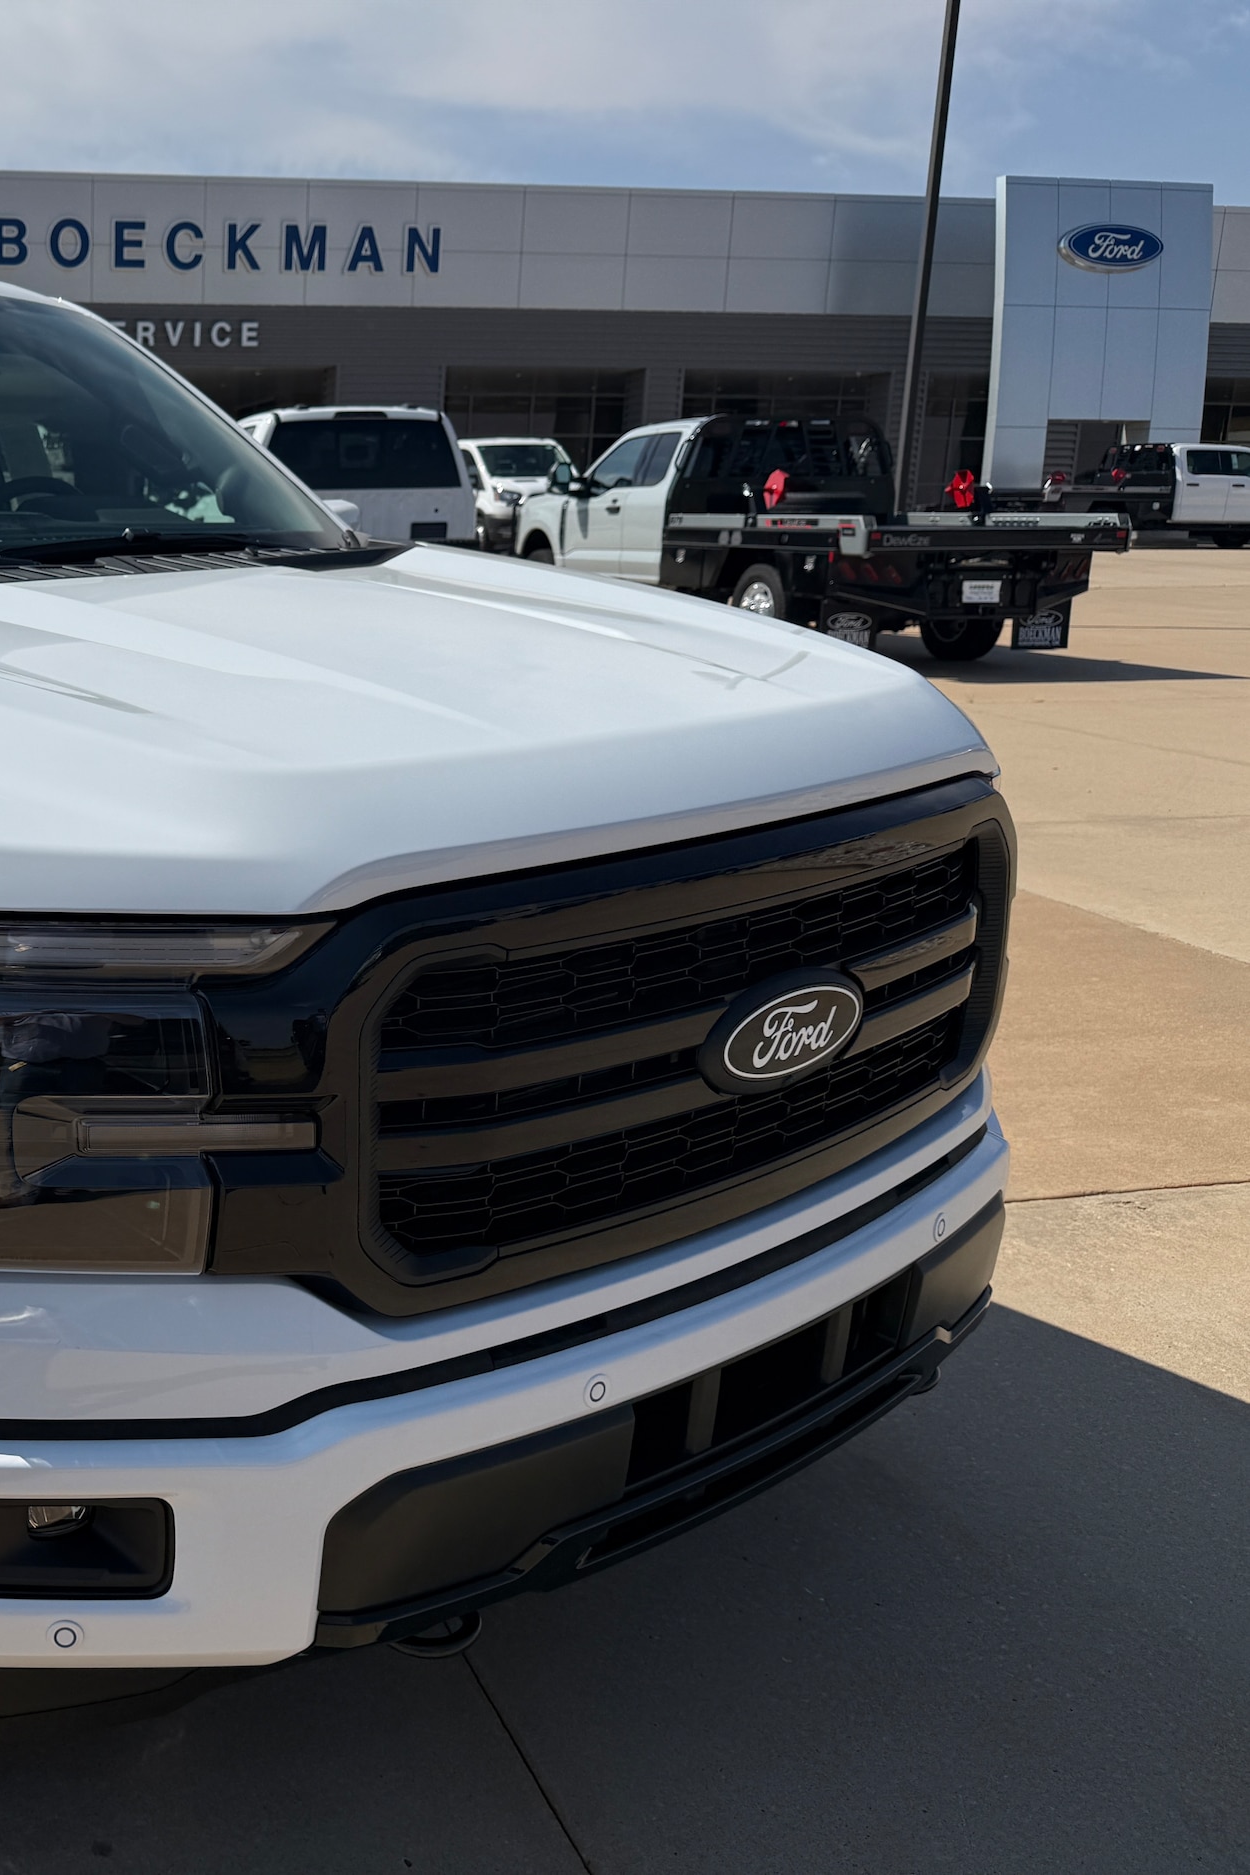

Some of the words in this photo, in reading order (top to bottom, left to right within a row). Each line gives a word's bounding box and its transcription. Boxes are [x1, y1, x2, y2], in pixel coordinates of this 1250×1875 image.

[1088, 232, 1145, 260] Ford
[109, 320, 260, 348] RVICE
[752, 999, 838, 1069] Ford
